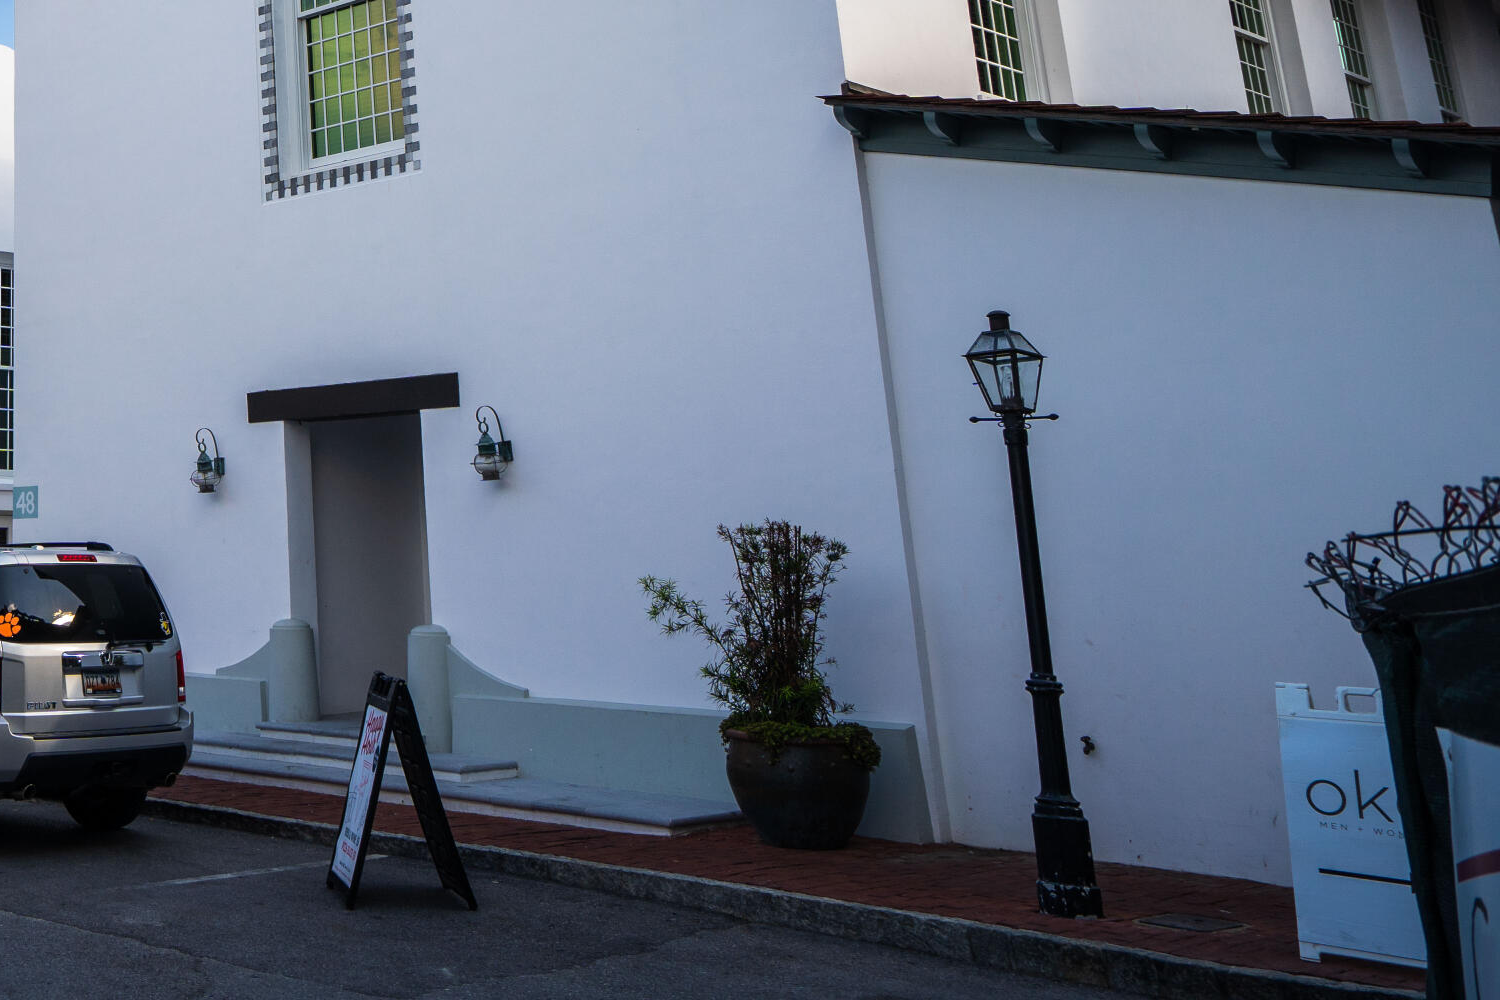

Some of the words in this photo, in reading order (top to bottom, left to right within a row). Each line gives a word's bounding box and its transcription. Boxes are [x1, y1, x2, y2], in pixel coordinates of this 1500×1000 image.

[15, 491, 35, 515] 48
[26, 701, 57, 710] PILOT
[1319, 821, 1348, 831] MEN
